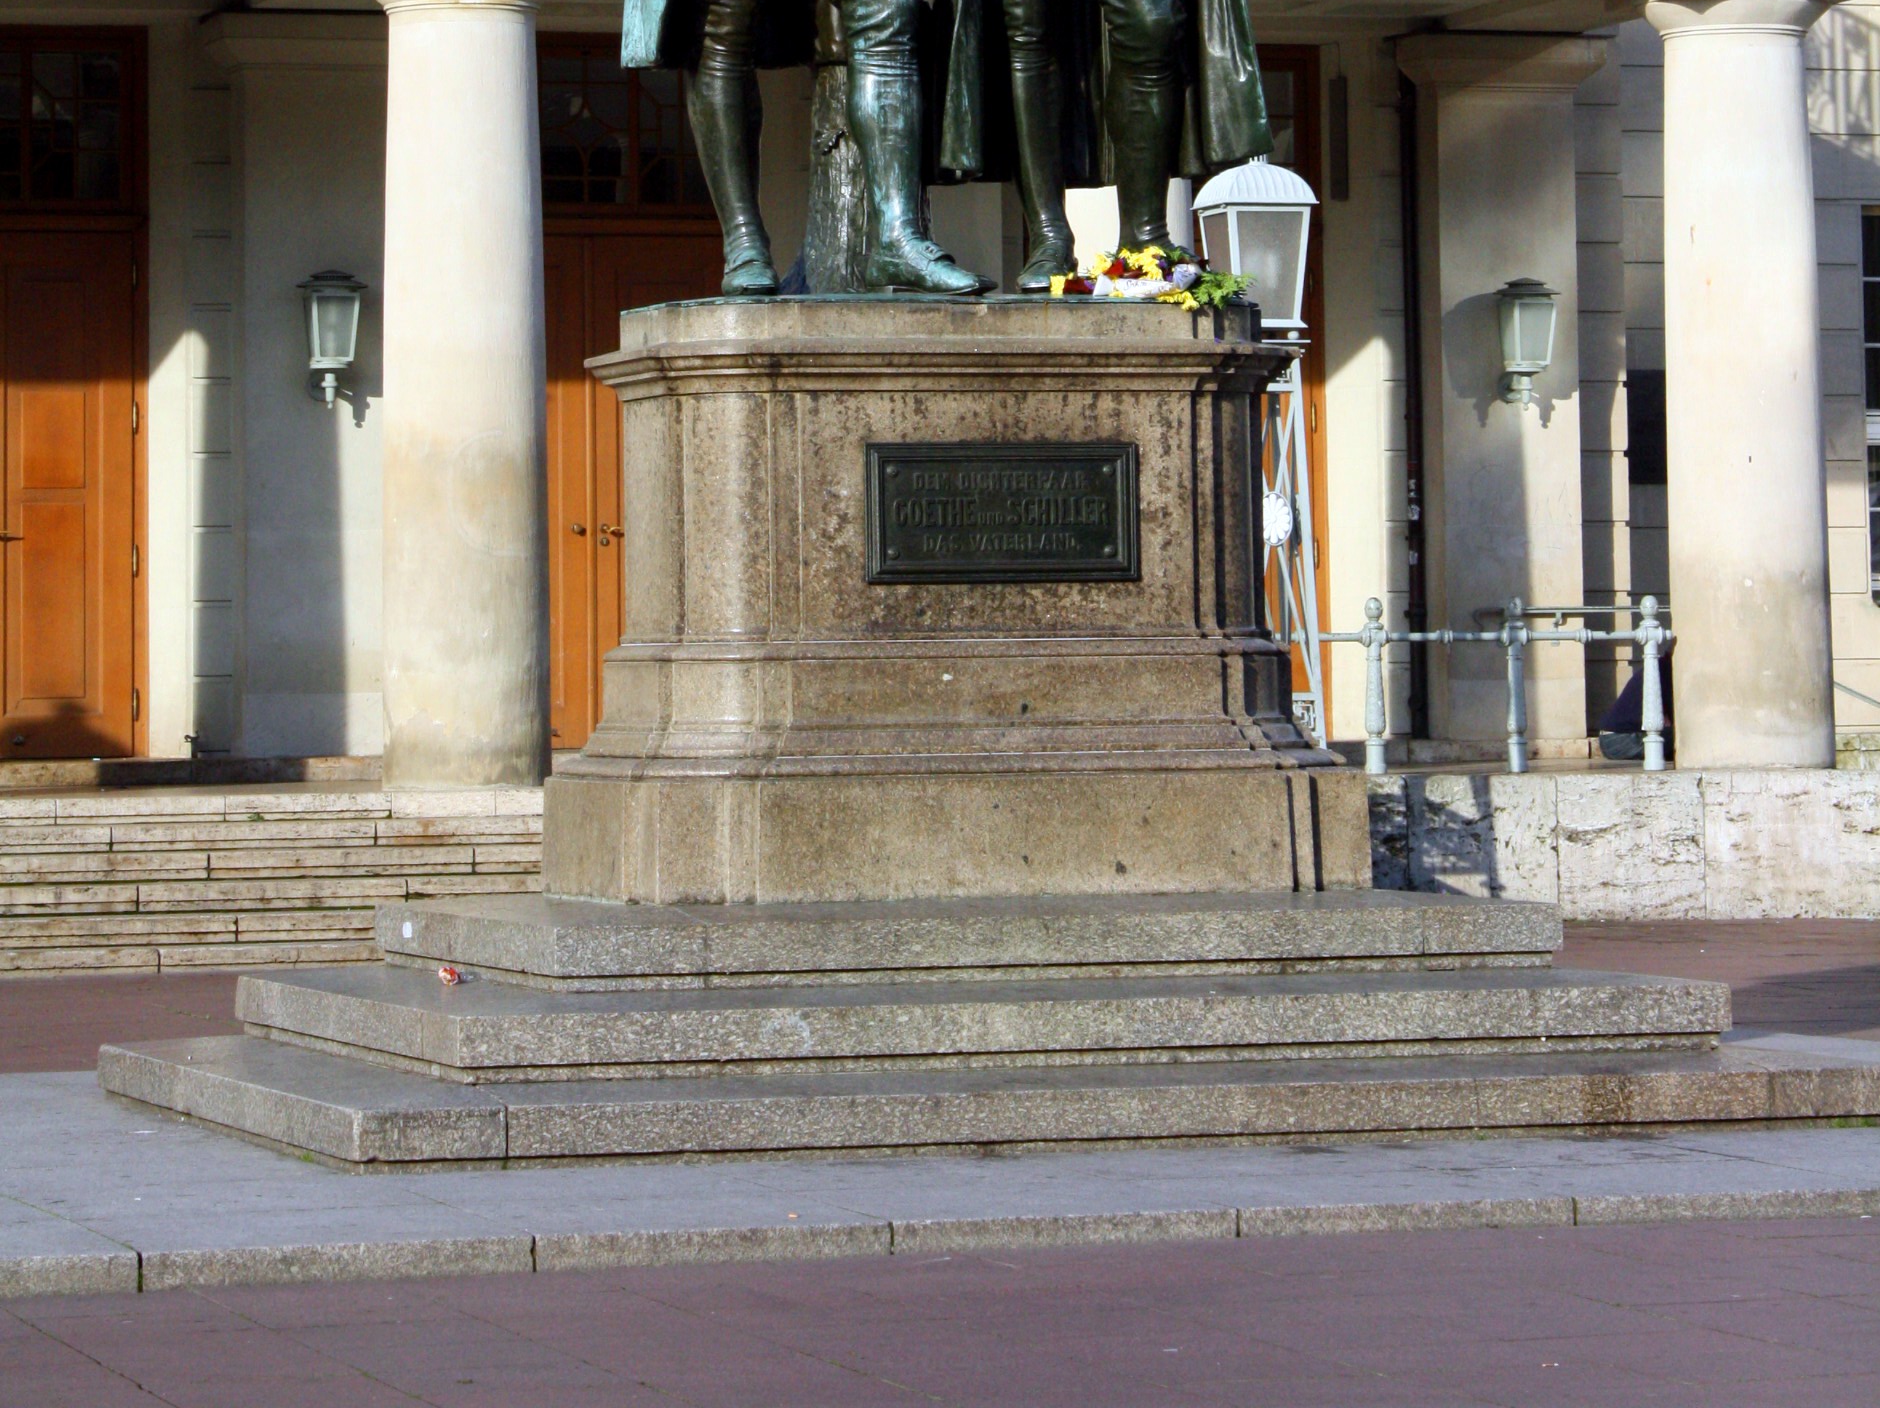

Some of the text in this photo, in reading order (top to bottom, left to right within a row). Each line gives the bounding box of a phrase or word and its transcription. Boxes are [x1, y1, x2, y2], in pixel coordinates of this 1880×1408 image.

[911, 470, 1088, 491] DEM DICHTERPAAR
[893, 496, 978, 527] GOETHE
[1007, 496, 1110, 526] SCHILLER
[923, 533, 961, 552] DAS
